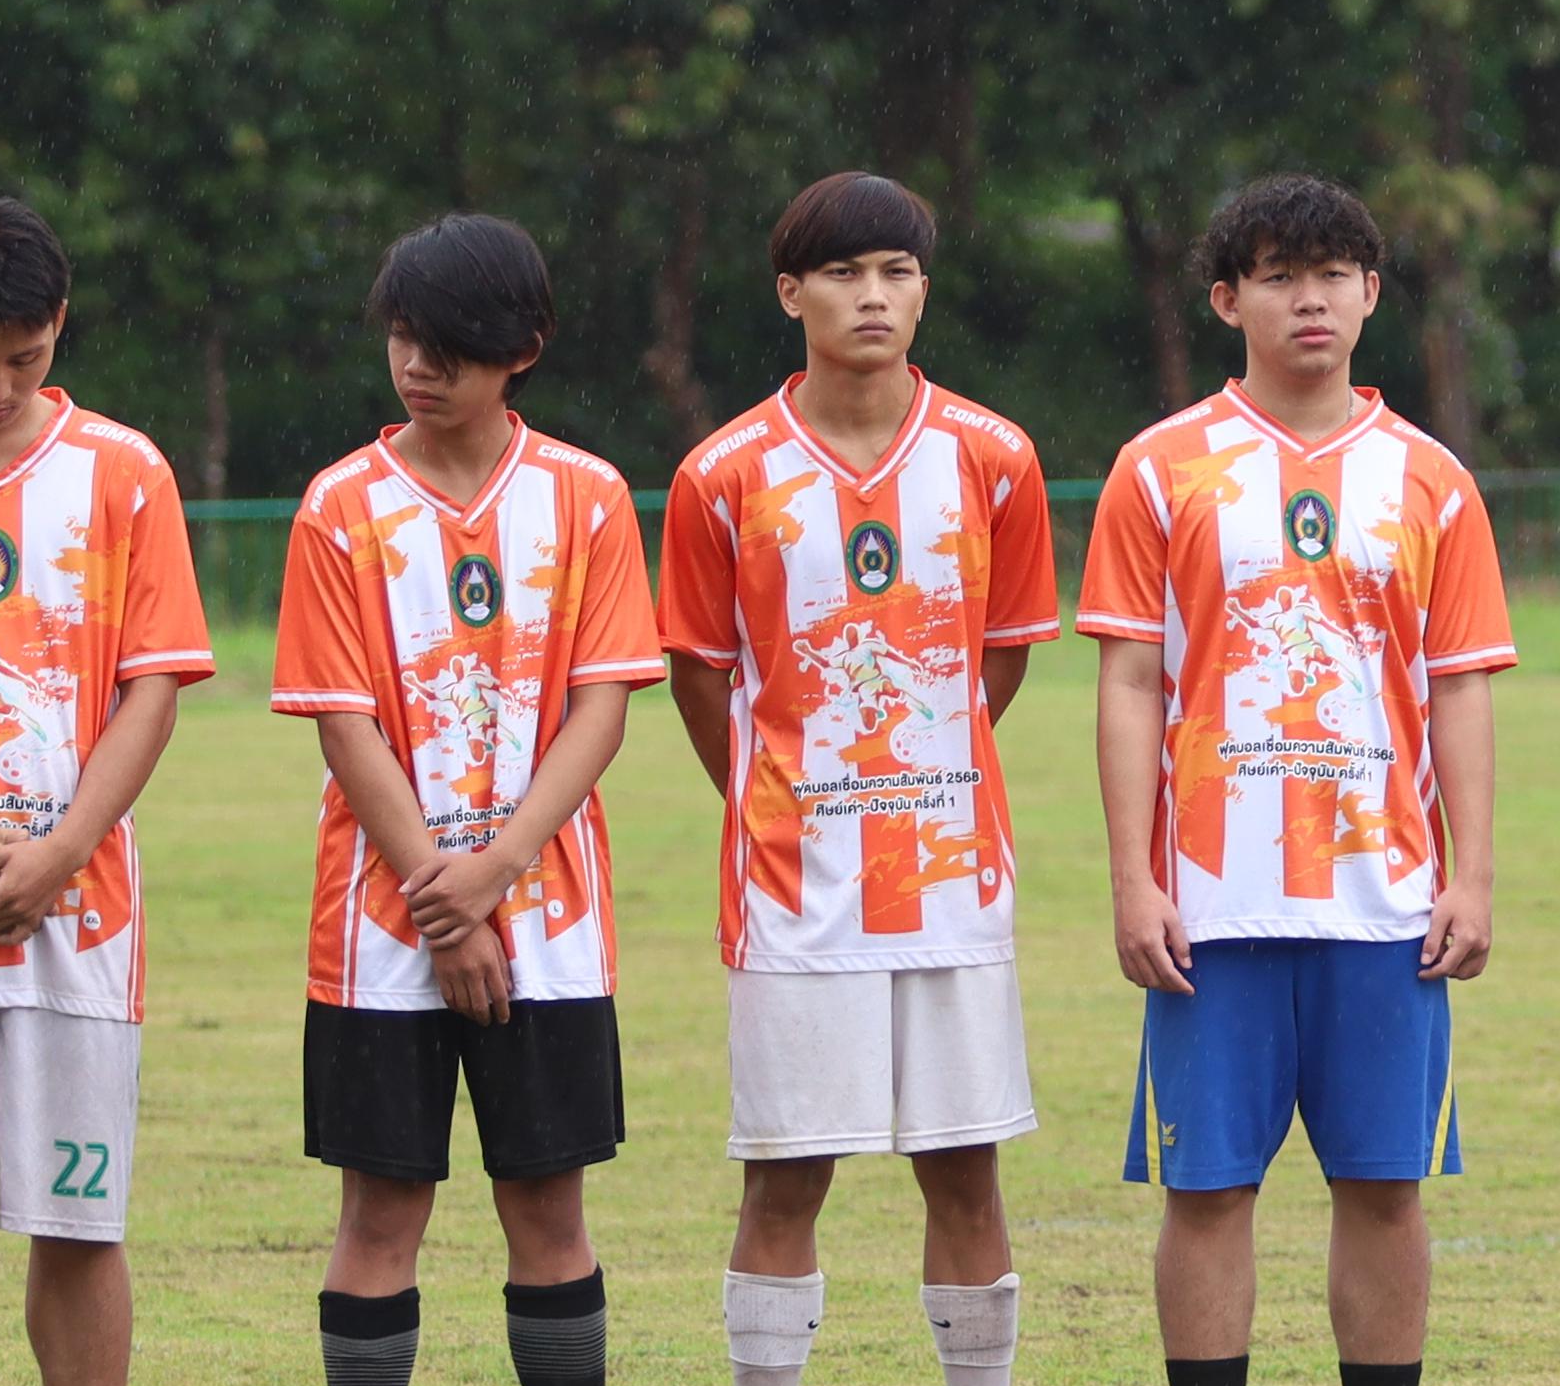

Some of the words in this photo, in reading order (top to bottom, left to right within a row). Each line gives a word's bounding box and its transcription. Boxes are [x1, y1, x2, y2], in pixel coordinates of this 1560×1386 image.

[80, 422, 161, 466] COMTMS
[697, 420, 769, 475] KPRUMS
[941, 403, 1023, 453] COMTMS
[537, 443, 618, 483] COMTMS
[1219, 735, 1365, 760] ฟุตบอลเชื่อมความสัมพันธ์
[1367, 748, 1395, 762] 2568
[793, 771, 943, 798] ฟุตบอลเชื่อมความสัมพันธ์
[946, 770, 980, 784] 2568
[1238, 761, 1335, 782] ศิษย์เก่า-ปัจจุบัน
[1338, 762, 1365, 780] ครั้งที่
[1368, 770, 1372, 781] 1
[815, 798, 911, 818] ศิษย์เก่า-ปัจจุบัน
[915, 790, 945, 810] ครั้งที่
[949, 796, 955, 807] 1
[51, 1138, 109, 1199] 22
